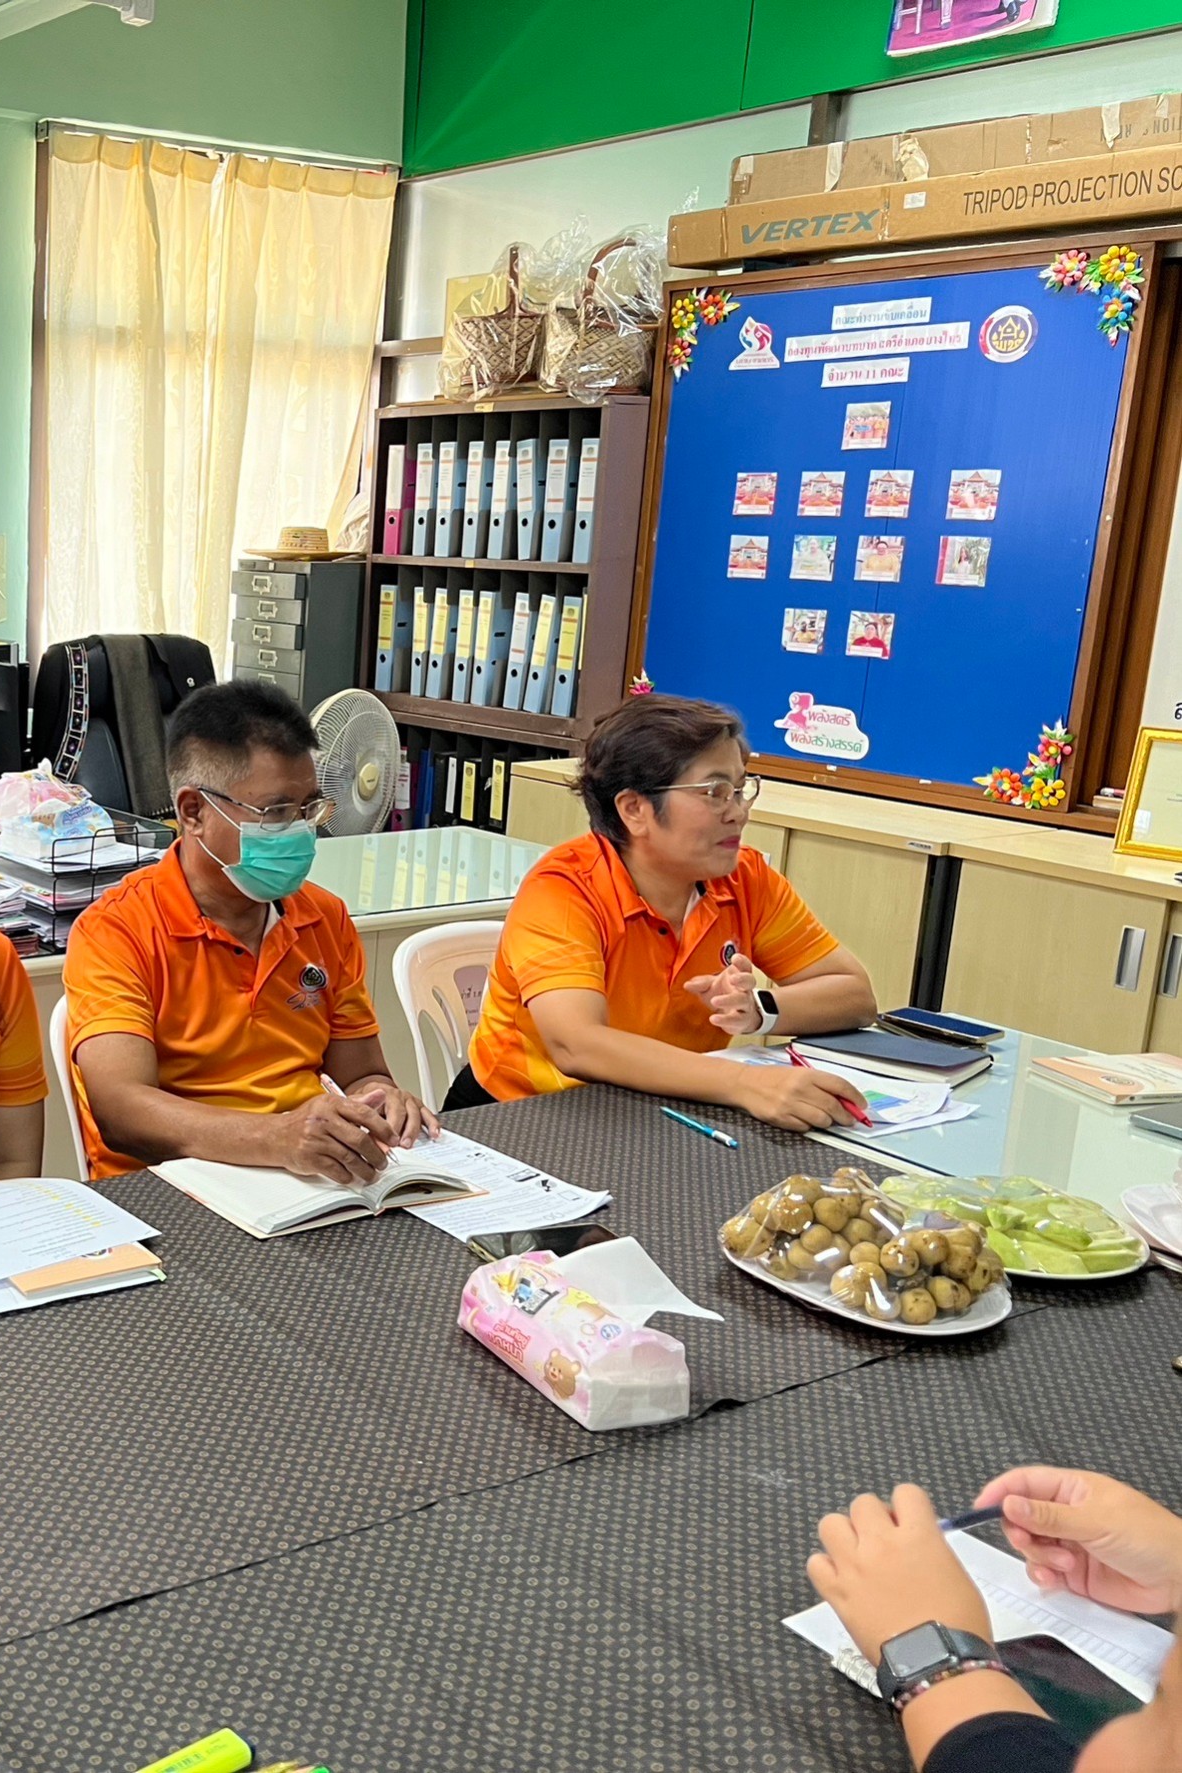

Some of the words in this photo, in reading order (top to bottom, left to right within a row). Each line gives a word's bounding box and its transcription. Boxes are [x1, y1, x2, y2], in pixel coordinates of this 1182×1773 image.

[963, 185, 1029, 217] TRIPOD
[1032, 169, 1153, 208] PROJECTION
[739, 209, 881, 246] VERTEX
[808, 709, 852, 726] พลังสตรี
[790, 731, 864, 753] พลังสร้างสรรค์
